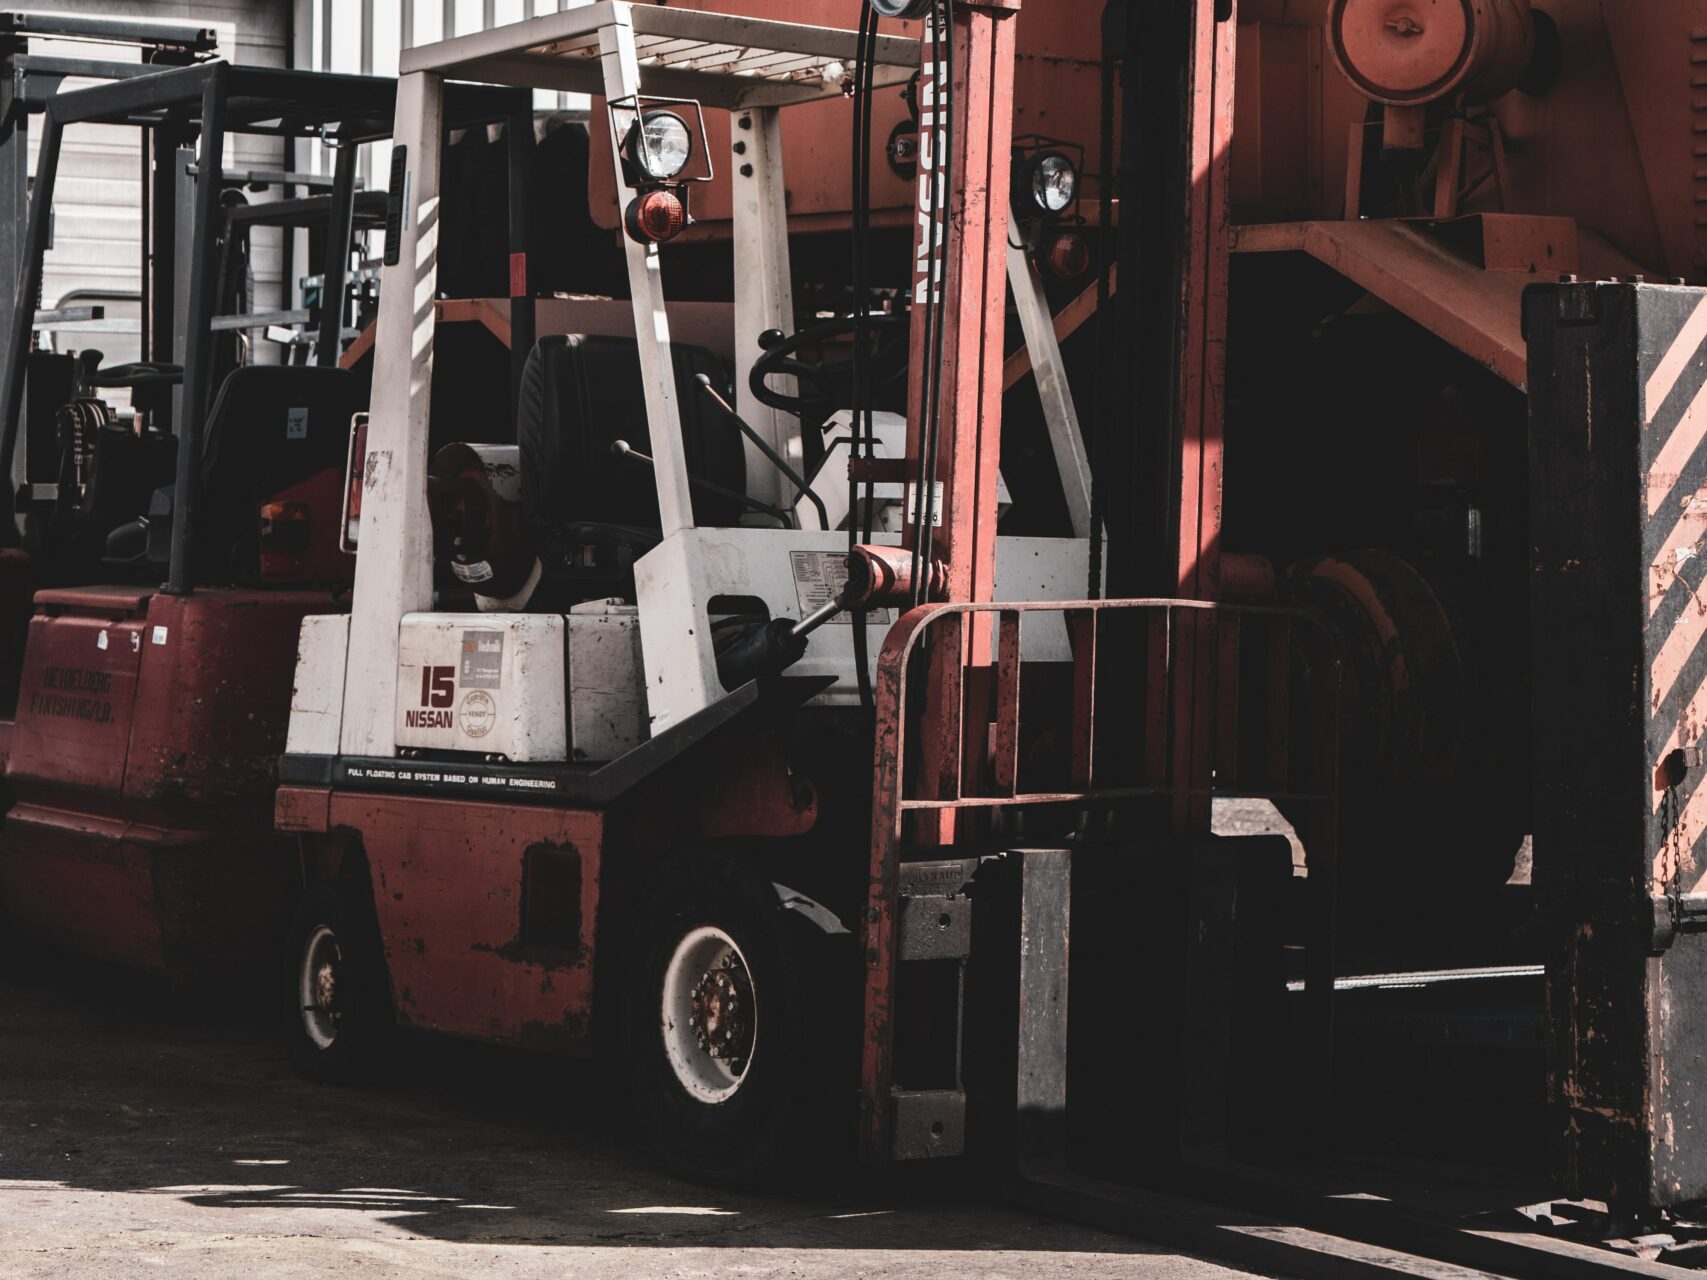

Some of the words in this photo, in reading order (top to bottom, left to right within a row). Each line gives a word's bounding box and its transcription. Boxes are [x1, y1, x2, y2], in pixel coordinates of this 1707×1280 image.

[915, 61, 948, 304] NISSAN
[421, 666, 455, 708] 15
[406, 711, 453, 729] NISSAN
[348, 768, 363, 777] FULL
[366, 770, 396, 779] FLOATING
[398, 771, 412, 780] CAB
[415, 773, 440, 781] SYSTEM
[443, 774, 466, 783] BASED
[482, 777, 506, 785] HUMAN
[509, 778, 556, 789] ENGINEERING
